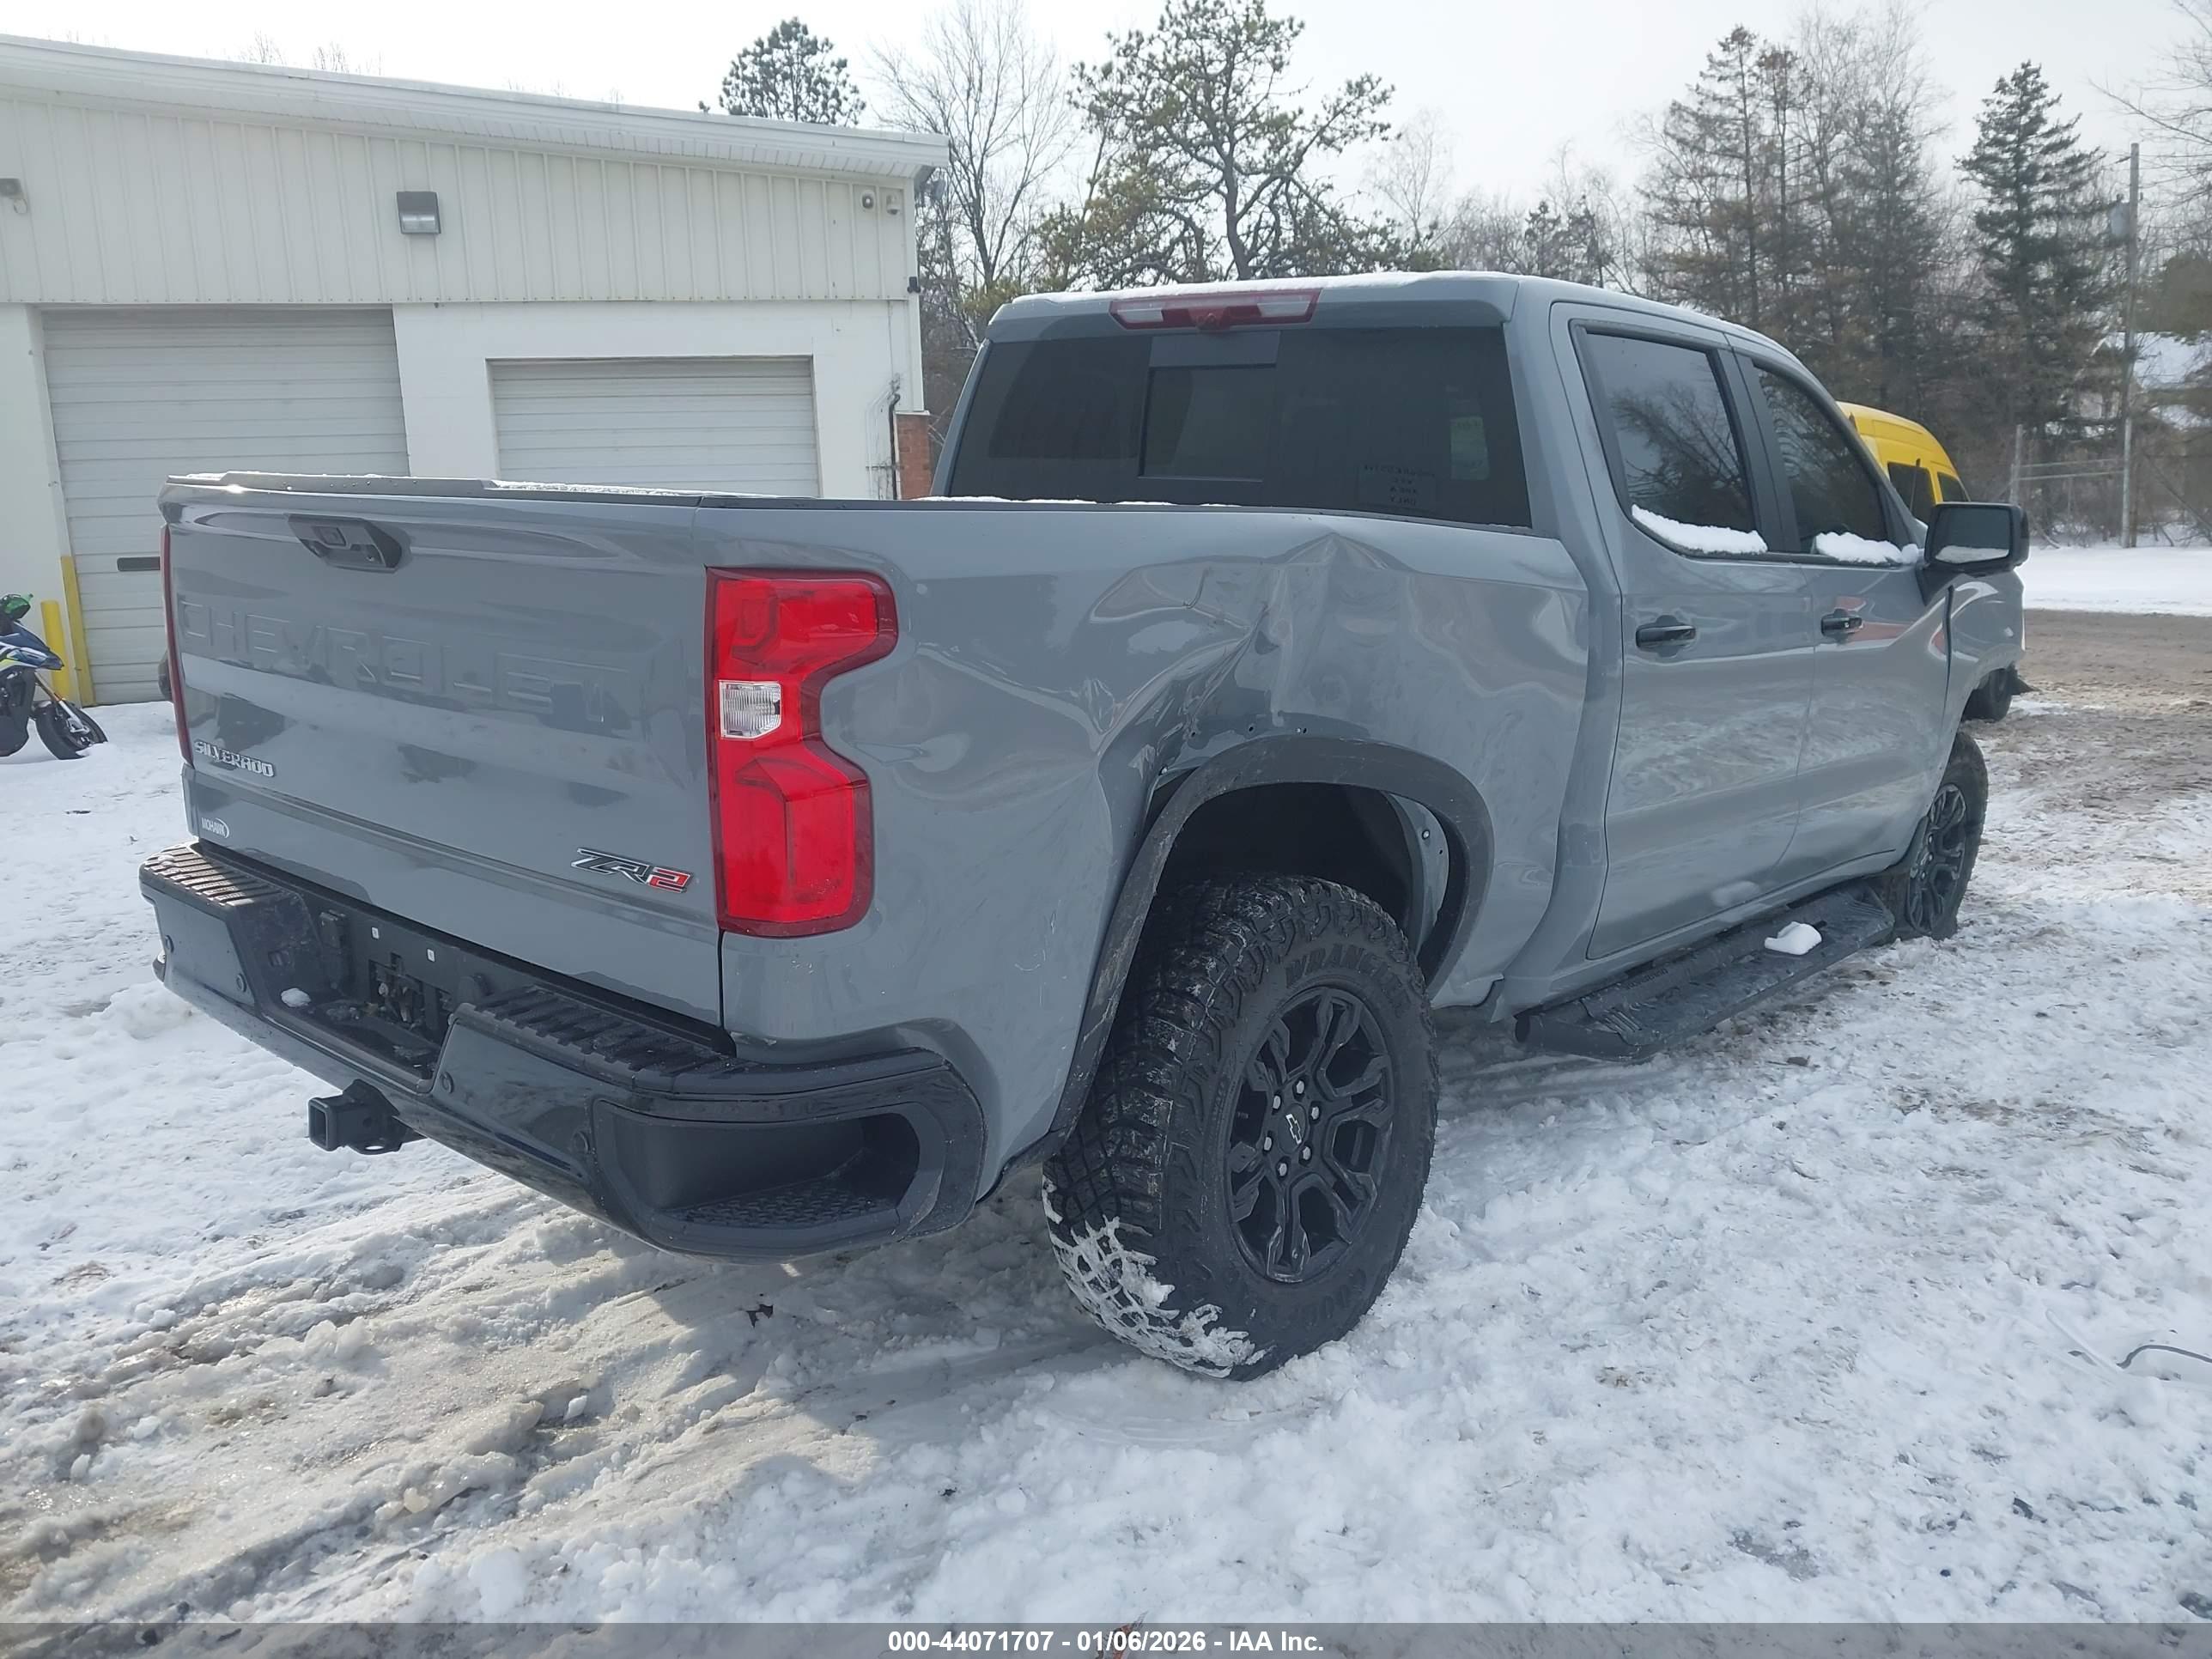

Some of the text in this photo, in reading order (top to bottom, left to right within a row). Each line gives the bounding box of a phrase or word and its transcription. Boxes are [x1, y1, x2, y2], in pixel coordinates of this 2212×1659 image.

[178, 597, 629, 723] CHEVROLET
[193, 739, 275, 778] SILVERADO
[201, 817, 226, 837] MOHAWK
[570, 848, 691, 894] ZR2
